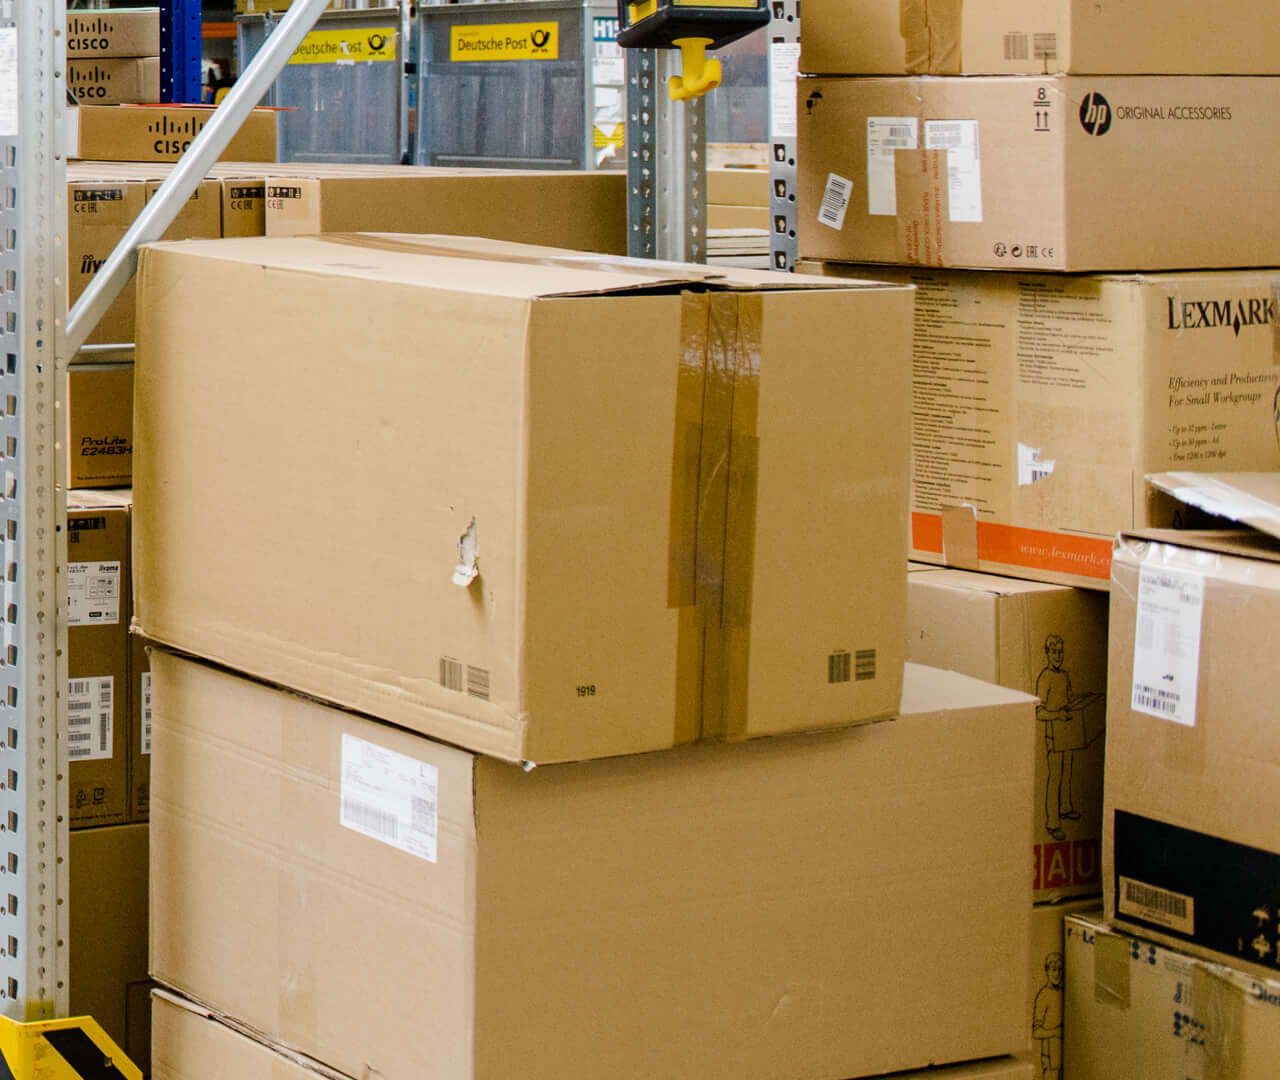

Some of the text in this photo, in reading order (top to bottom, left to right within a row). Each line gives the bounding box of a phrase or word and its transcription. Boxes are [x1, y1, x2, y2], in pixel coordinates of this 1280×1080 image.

[458, 36, 528, 52] Deutsche Post
[72, 86, 107, 99] ISCO
[1079, 91, 1233, 137] hp ORIGINAL ACCESSORIES
[153, 139, 191, 155] CISC
[1167, 295, 1274, 336] LEXMARK
[1168, 375, 1210, 390] Efficiency
[1210, 374, 1228, 386] and
[1168, 392, 1262, 409] For Small Workgroups
[80, 445, 133, 457] E2483H
[575, 684, 596, 698] 1919
